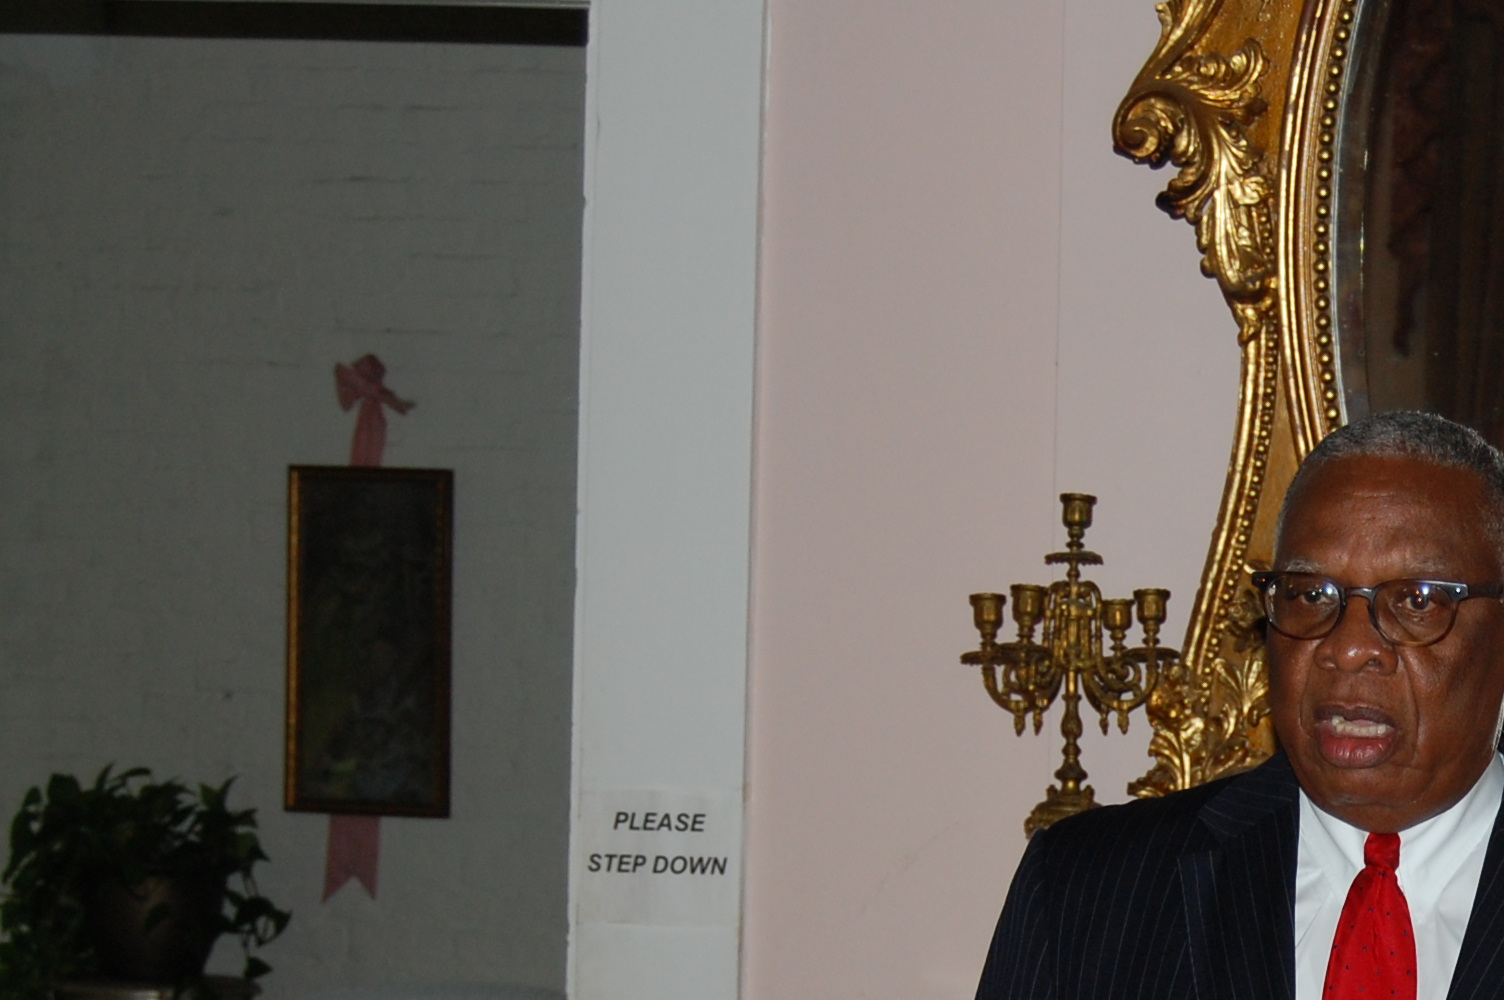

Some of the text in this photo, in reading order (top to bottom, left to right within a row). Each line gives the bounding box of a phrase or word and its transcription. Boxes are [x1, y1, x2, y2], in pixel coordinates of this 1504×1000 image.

[613, 811, 706, 832] PLEASE
[587, 853, 728, 875] STEP DOWN
